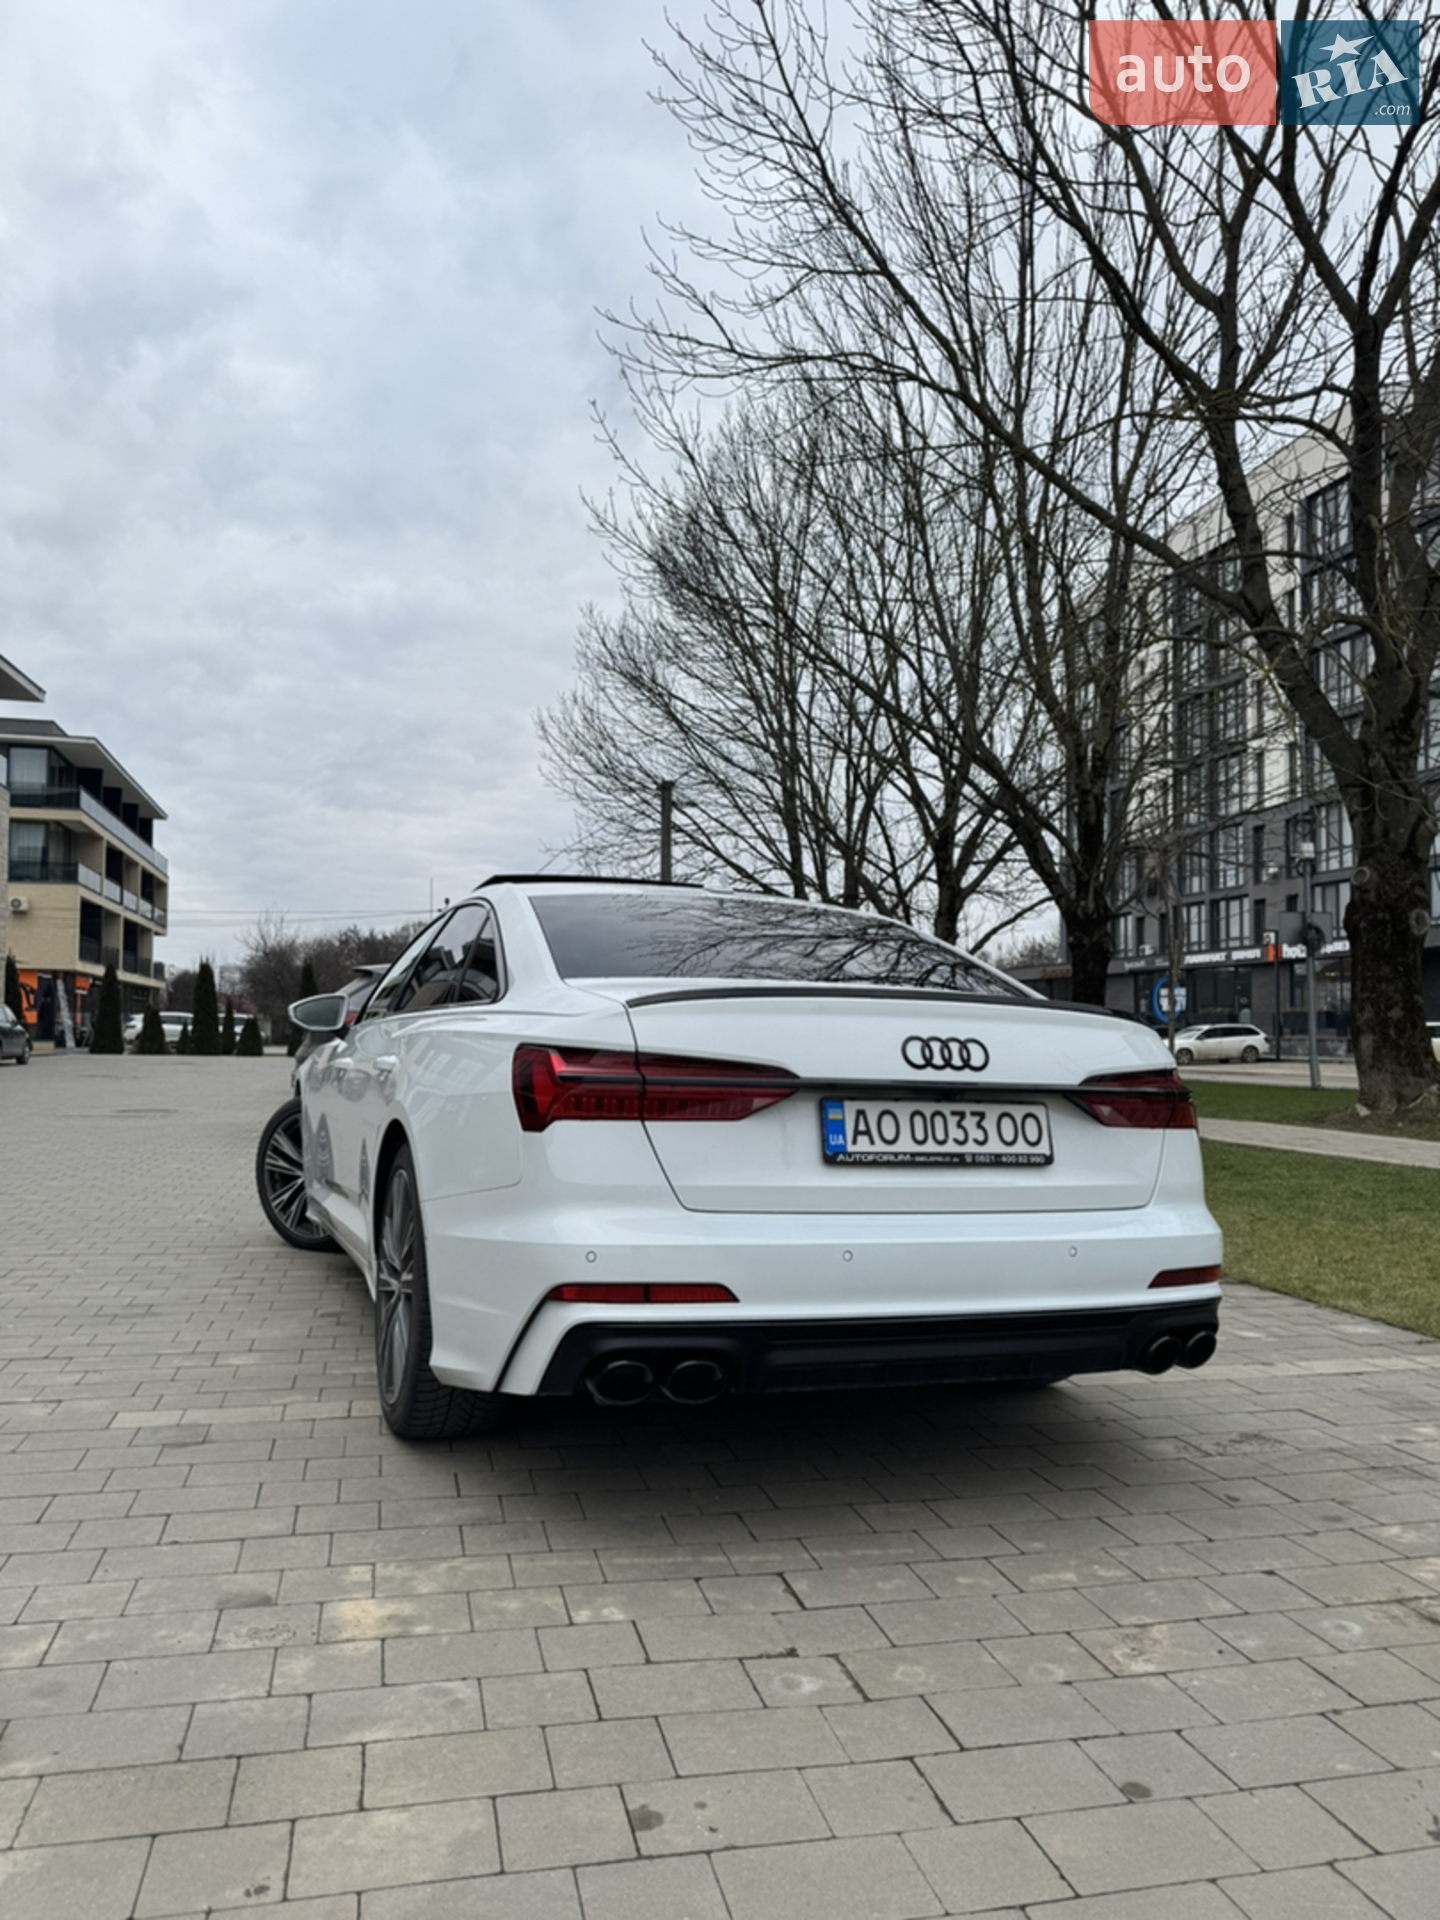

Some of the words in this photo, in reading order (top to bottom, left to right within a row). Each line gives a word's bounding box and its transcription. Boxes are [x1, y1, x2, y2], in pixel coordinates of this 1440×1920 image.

[829, 1134, 845, 1146] UA
[851, 1109, 900, 1146] AO
[909, 1109, 989, 1146] 0033
[996, 1111, 1043, 1147] OO
